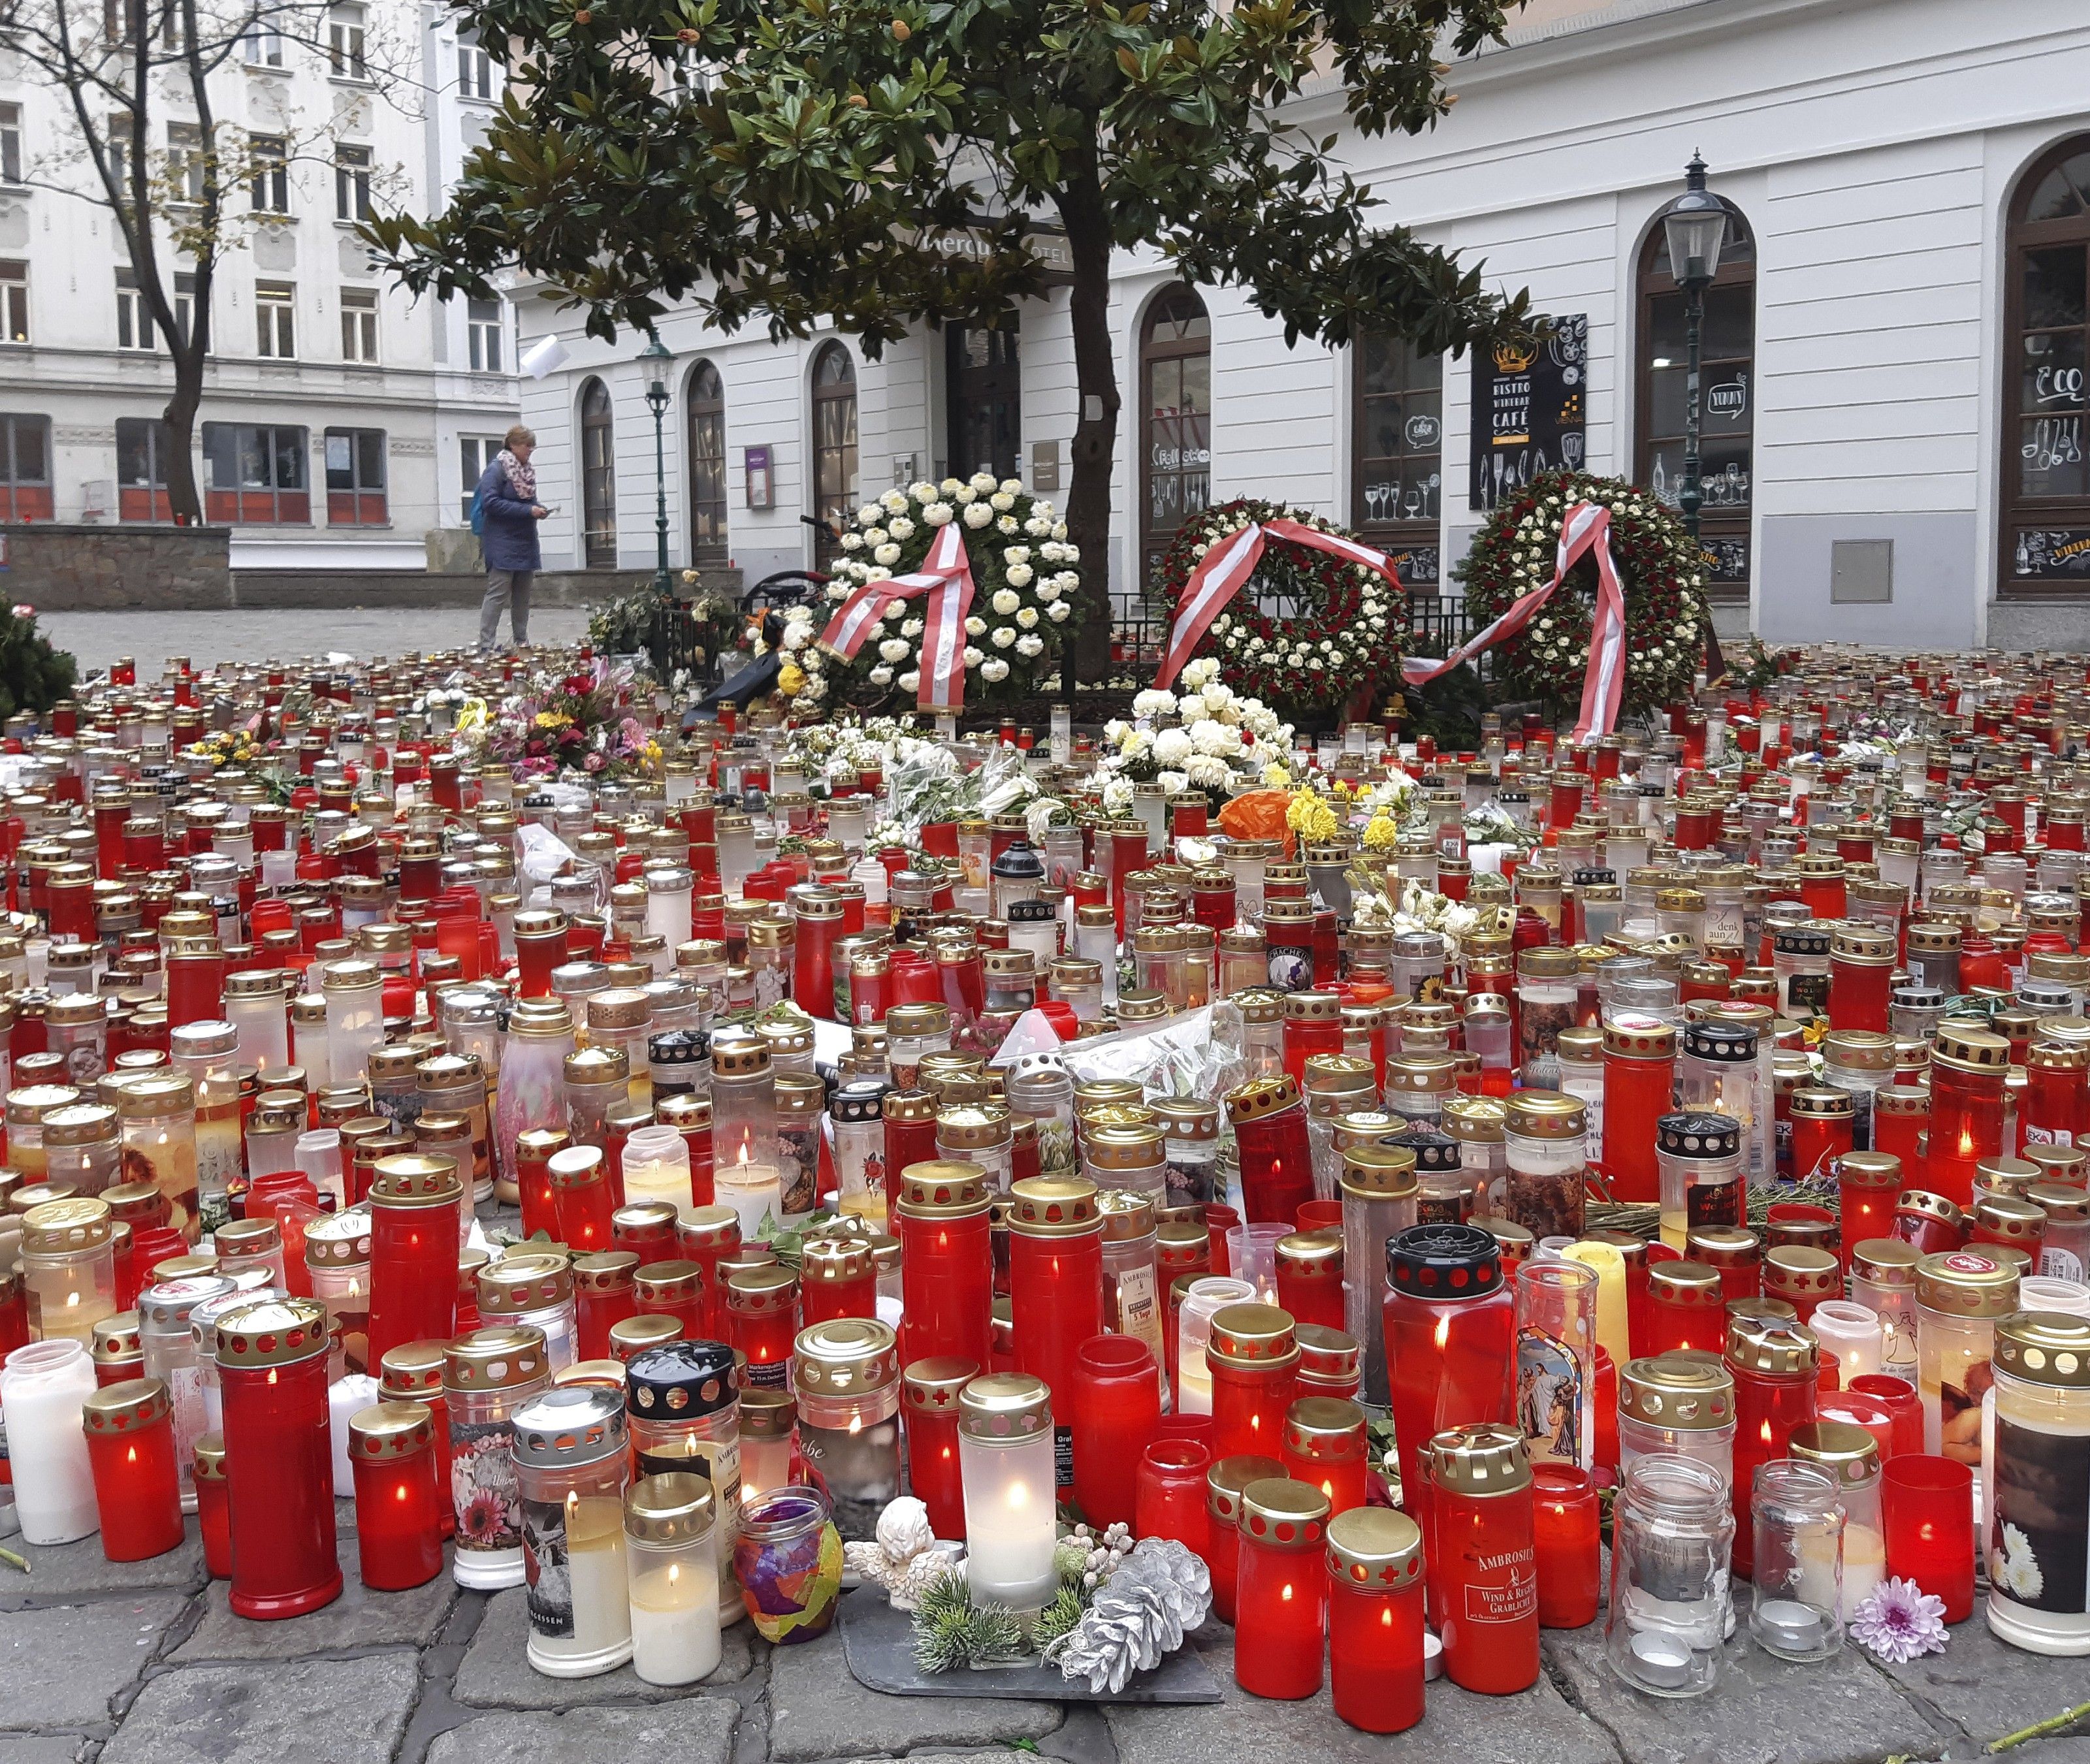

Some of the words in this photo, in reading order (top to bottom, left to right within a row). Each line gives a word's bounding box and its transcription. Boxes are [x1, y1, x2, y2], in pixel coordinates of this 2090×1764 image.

[1031, 246, 1069, 264] OTEL
[1493, 382, 1530, 396] BISTRO
[1493, 396, 1530, 408] WINEBAR
[1712, 390, 1744, 406] YUMMY
[1492, 406, 1528, 427] CAFÉ
[1718, 922, 1738, 931] denk
[1123, 1270, 1152, 1285] AMBROSIUS
[799, 1436, 826, 1459] iebe
[1478, 1544, 1535, 1573] AMBROSIUS
[1481, 1590, 1505, 1603] WIND
[1507, 1590, 1514, 1601] &
[1490, 1596, 1530, 1614] GRABLICHT
